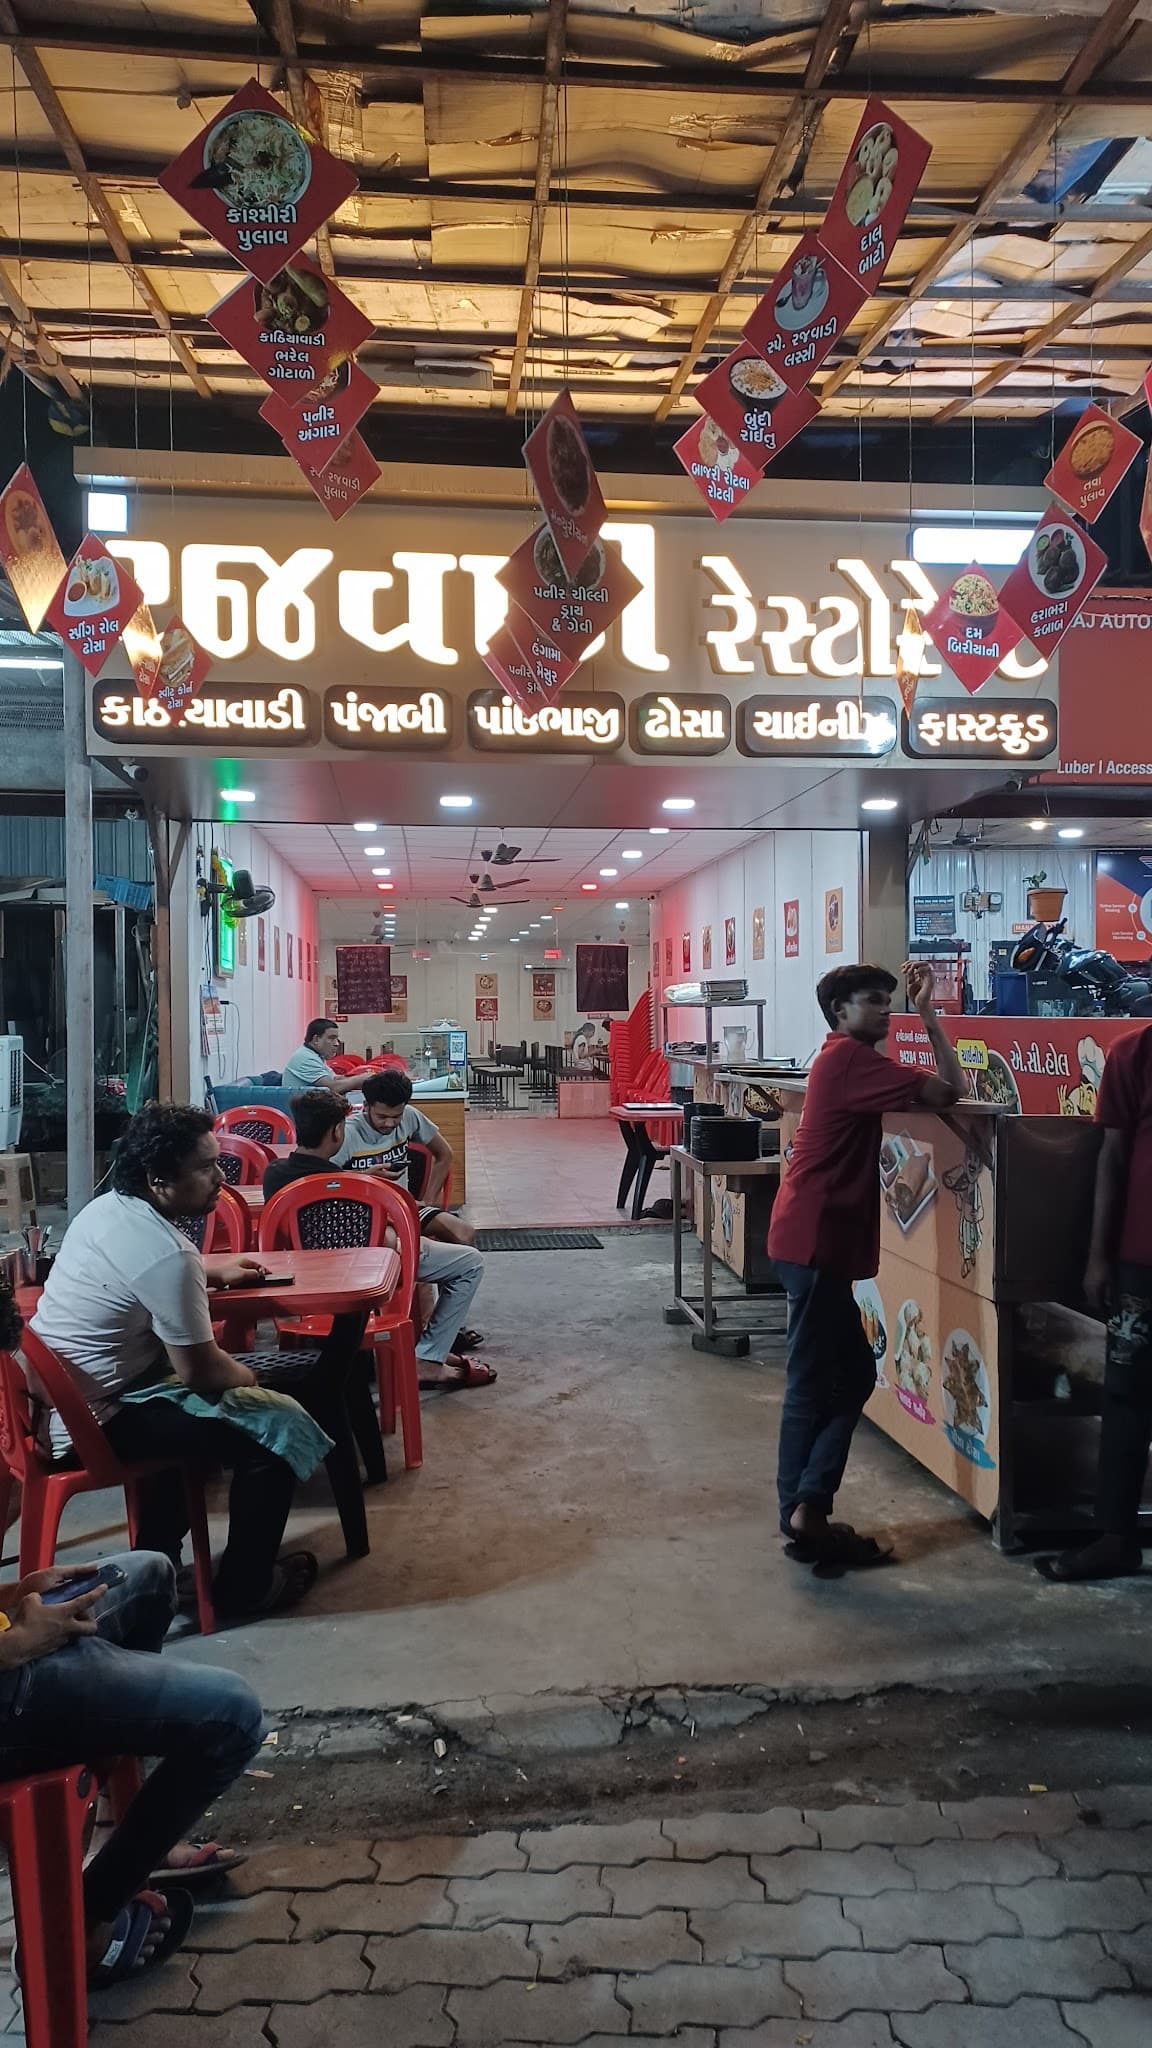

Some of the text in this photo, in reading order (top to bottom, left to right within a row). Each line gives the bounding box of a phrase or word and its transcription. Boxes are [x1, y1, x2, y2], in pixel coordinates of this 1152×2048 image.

[226, 203, 297, 223] કાશ્મીરી
[237, 230, 288, 251] પુલાવ
[861, 224, 882, 251] દાલ
[859, 241, 885, 274] બાટી
[259, 330, 325, 346] કાઠિયાવાડી
[791, 316, 837, 346] રજવાડી
[275, 347, 309, 363] ભરેલ
[784, 343, 815, 367] લસ્સી
[268, 364, 315, 380] ગોટાળો
[302, 405, 335, 422] પનીર
[328, 472, 360, 490] રજવાડી
[691, 462, 750, 490] બાજરી રોટલા
[1083, 476, 1101, 490] તવા
[323, 484, 347, 500] પુલાવ
[707, 481, 734, 503] રોટલી
[1080, 488, 1105, 508] પુલાવ
[534, 584, 566, 600] પનીર
[560, 605, 584, 619] ડ્રાય
[1030, 601, 1068, 624] હરાભરા
[99, 617, 119, 634] રોલ
[552, 618, 561, 632] &
[965, 626, 982, 639] દમ
[1033, 618, 1064, 638] કબાબ
[82, 637, 105, 655] ઢોસા
[531, 638, 561, 662] હંગામા
[947, 637, 999, 657] બિરીયાની
[330, 690, 447, 734] પંજાબી
[644, 697, 725, 738] ઢોસા
[1057, 760, 1095, 774] Luber
[1009, 1040, 1070, 1077] એ.સી.હોલ
[351, 1158, 373, 1168] JOE
